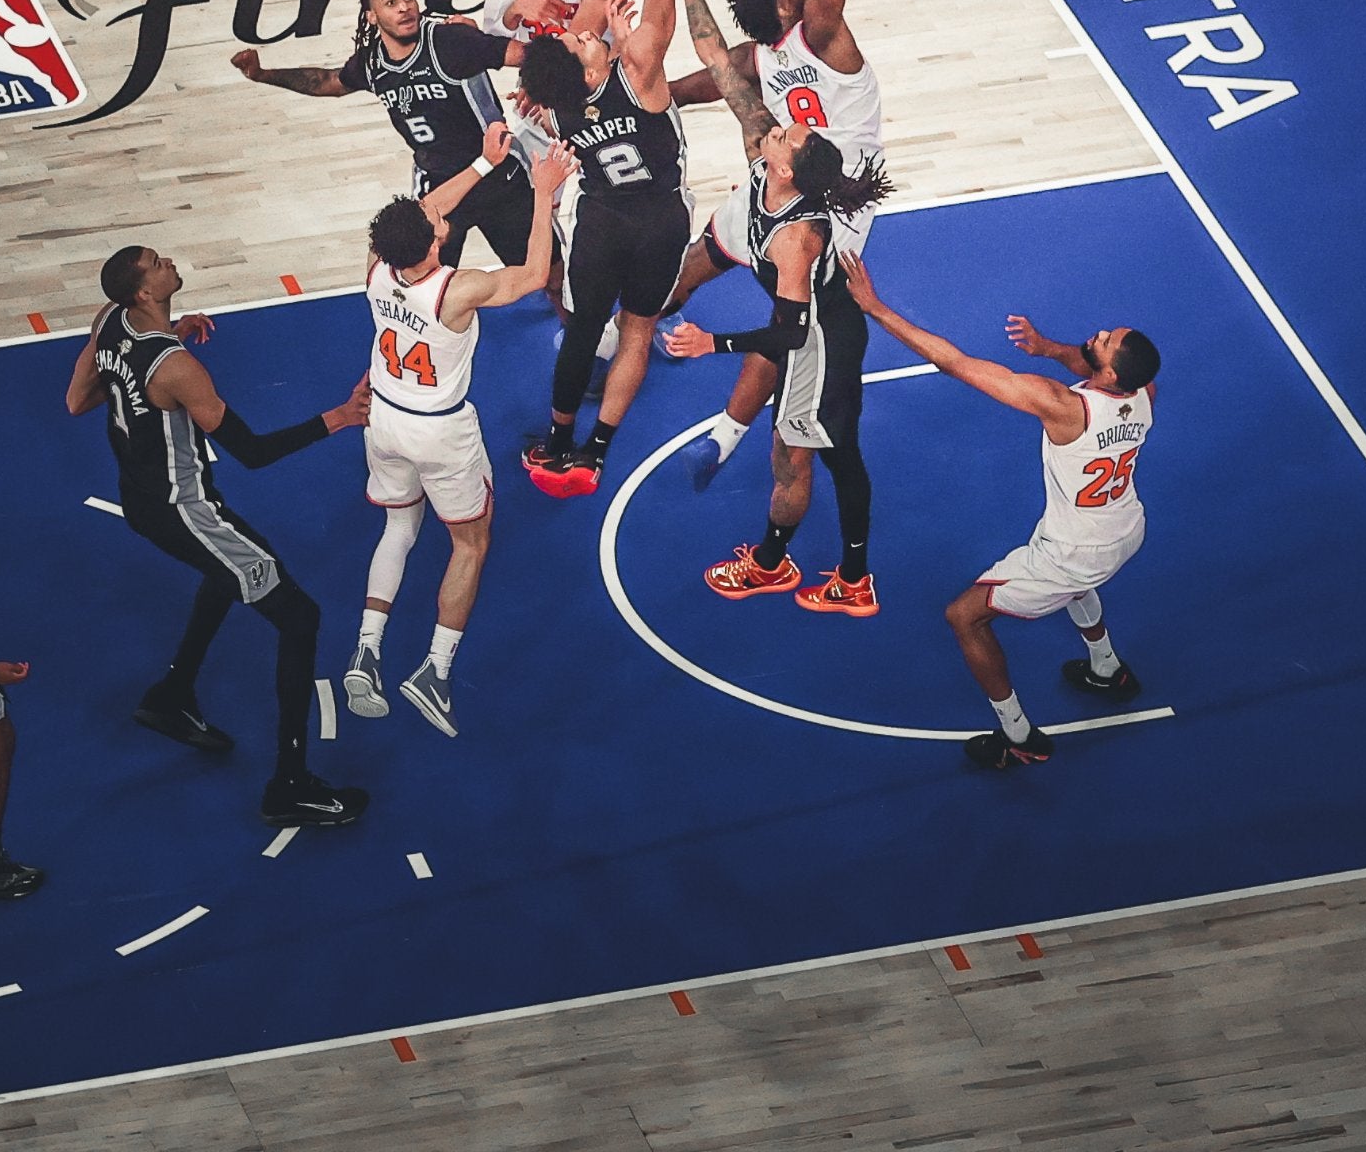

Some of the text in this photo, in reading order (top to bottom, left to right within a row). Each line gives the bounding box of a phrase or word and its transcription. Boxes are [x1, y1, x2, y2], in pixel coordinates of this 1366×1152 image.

[381, 81, 448, 115] SPURS
[767, 64, 819, 95] ANUNOBY
[786, 86, 828, 128] 8
[404, 114, 437, 144] 5
[569, 114, 638, 150] HARPER
[594, 142, 653, 187] 2
[376, 298, 429, 335] SHAMET
[379, 328, 438, 388] 44
[95, 351, 150, 417] EMBANYAMA
[109, 381, 131, 439] 1
[1096, 423, 1145, 450] BRIDGES
[1075, 446, 1140, 507] 25
